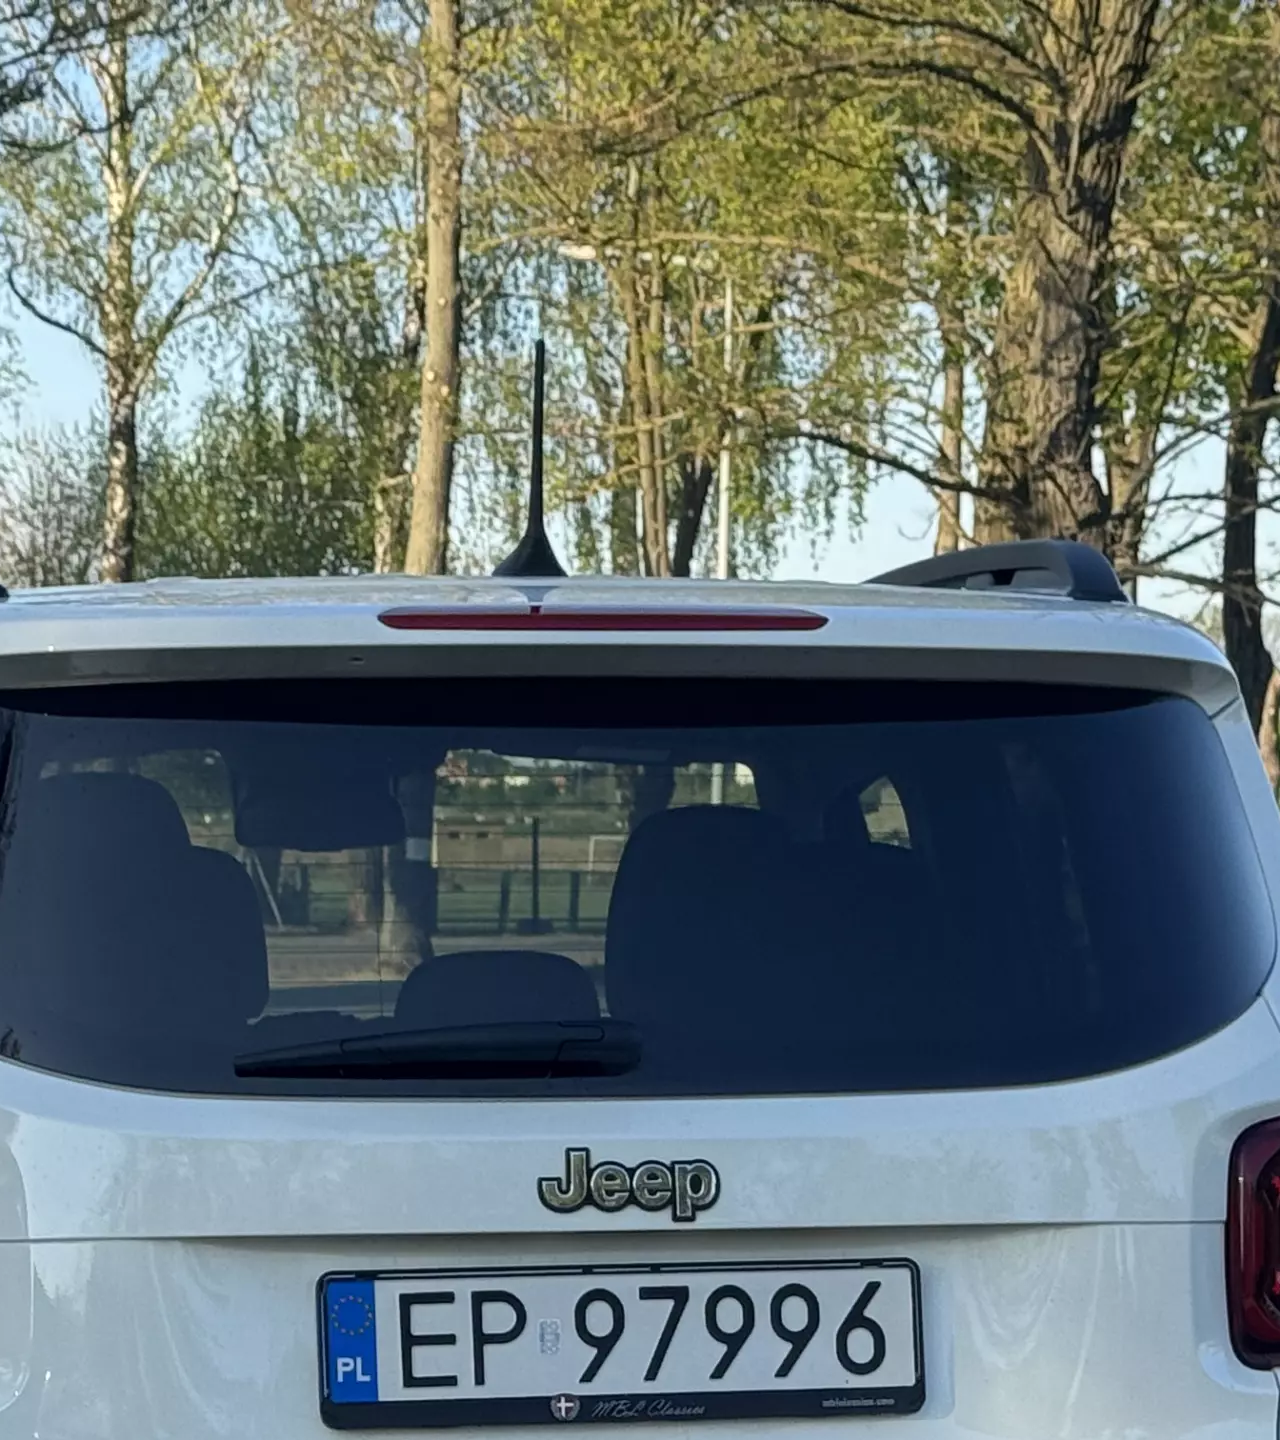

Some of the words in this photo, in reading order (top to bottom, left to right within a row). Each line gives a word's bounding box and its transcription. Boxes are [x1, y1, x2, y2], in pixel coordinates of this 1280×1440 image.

[537, 1147, 720, 1221] Jeep
[337, 1357, 371, 1382] PL
[398, 1290, 527, 1388] EP
[574, 1281, 886, 1383] 97996
